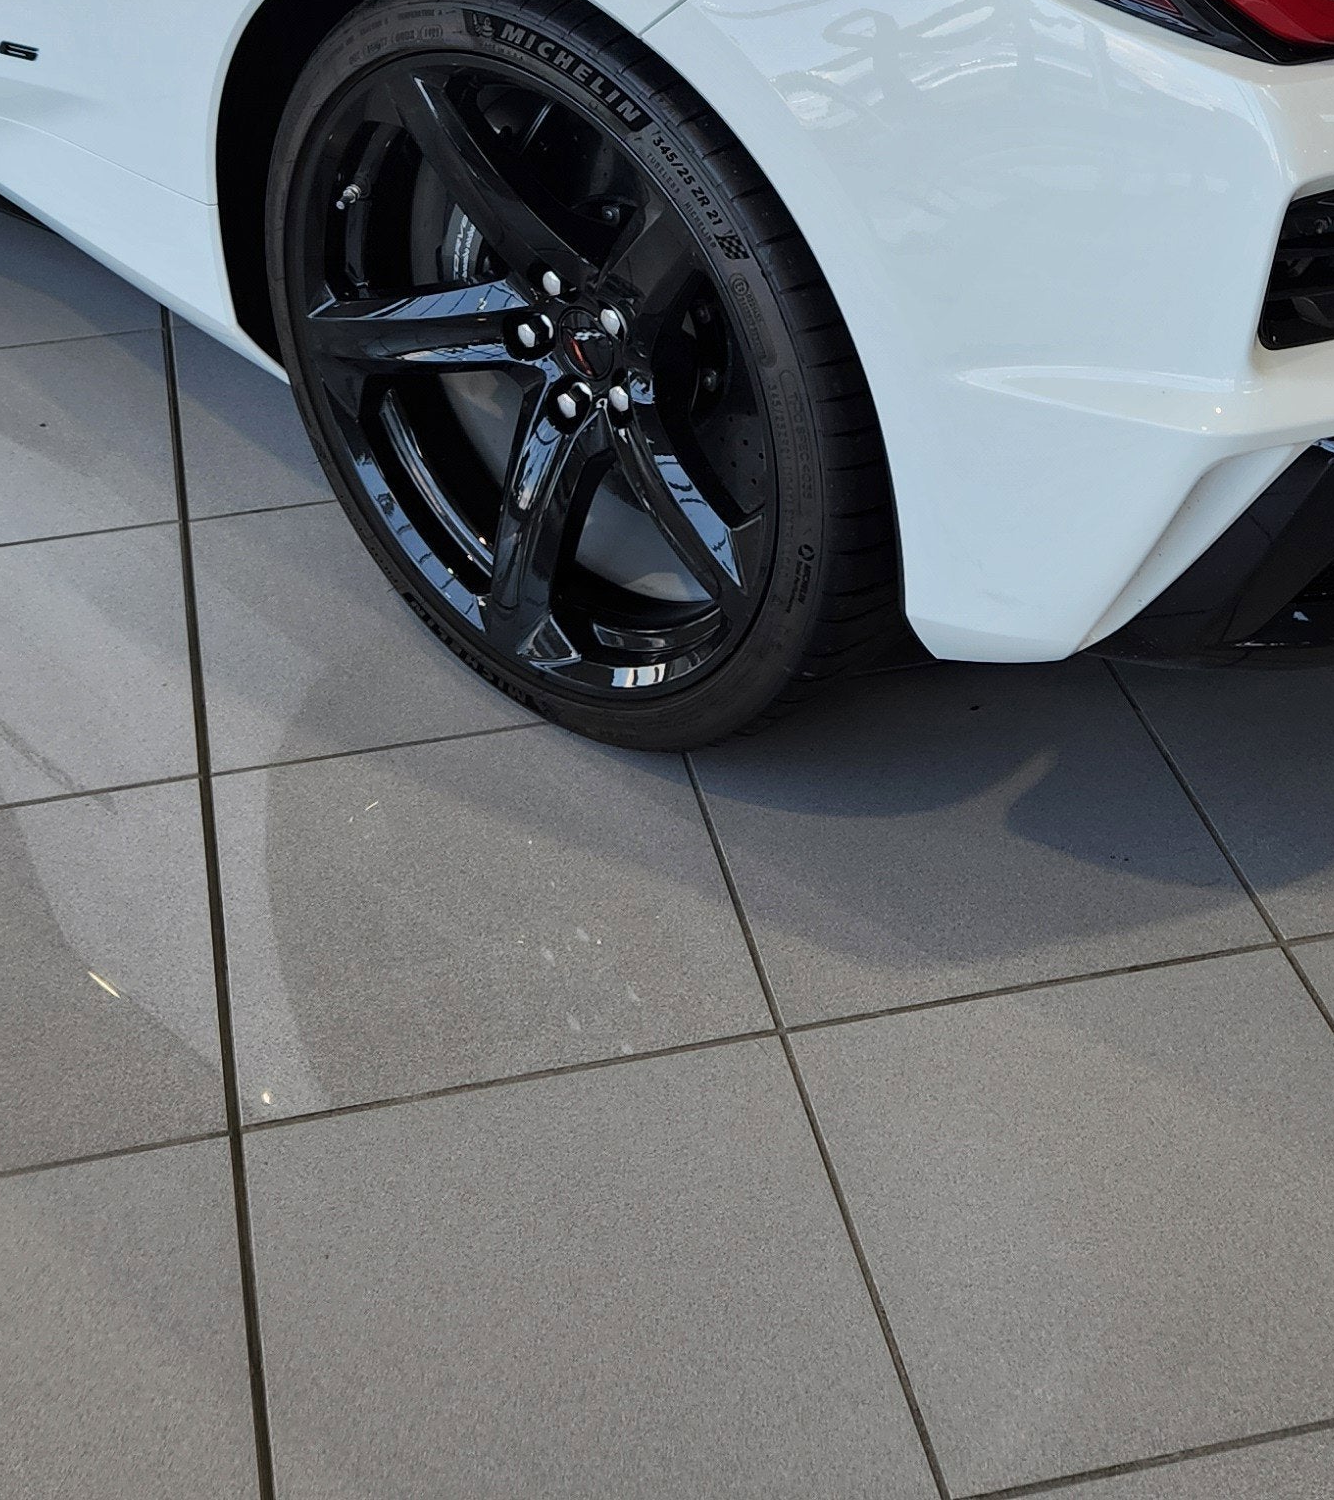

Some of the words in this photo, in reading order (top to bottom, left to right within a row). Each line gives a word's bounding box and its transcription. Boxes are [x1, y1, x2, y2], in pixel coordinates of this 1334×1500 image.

[500, 21, 643, 123] MICHELIN
[652, 136, 696, 186] 345/25
[691, 186, 711, 208] ZR
[706, 206, 724, 227] 21
